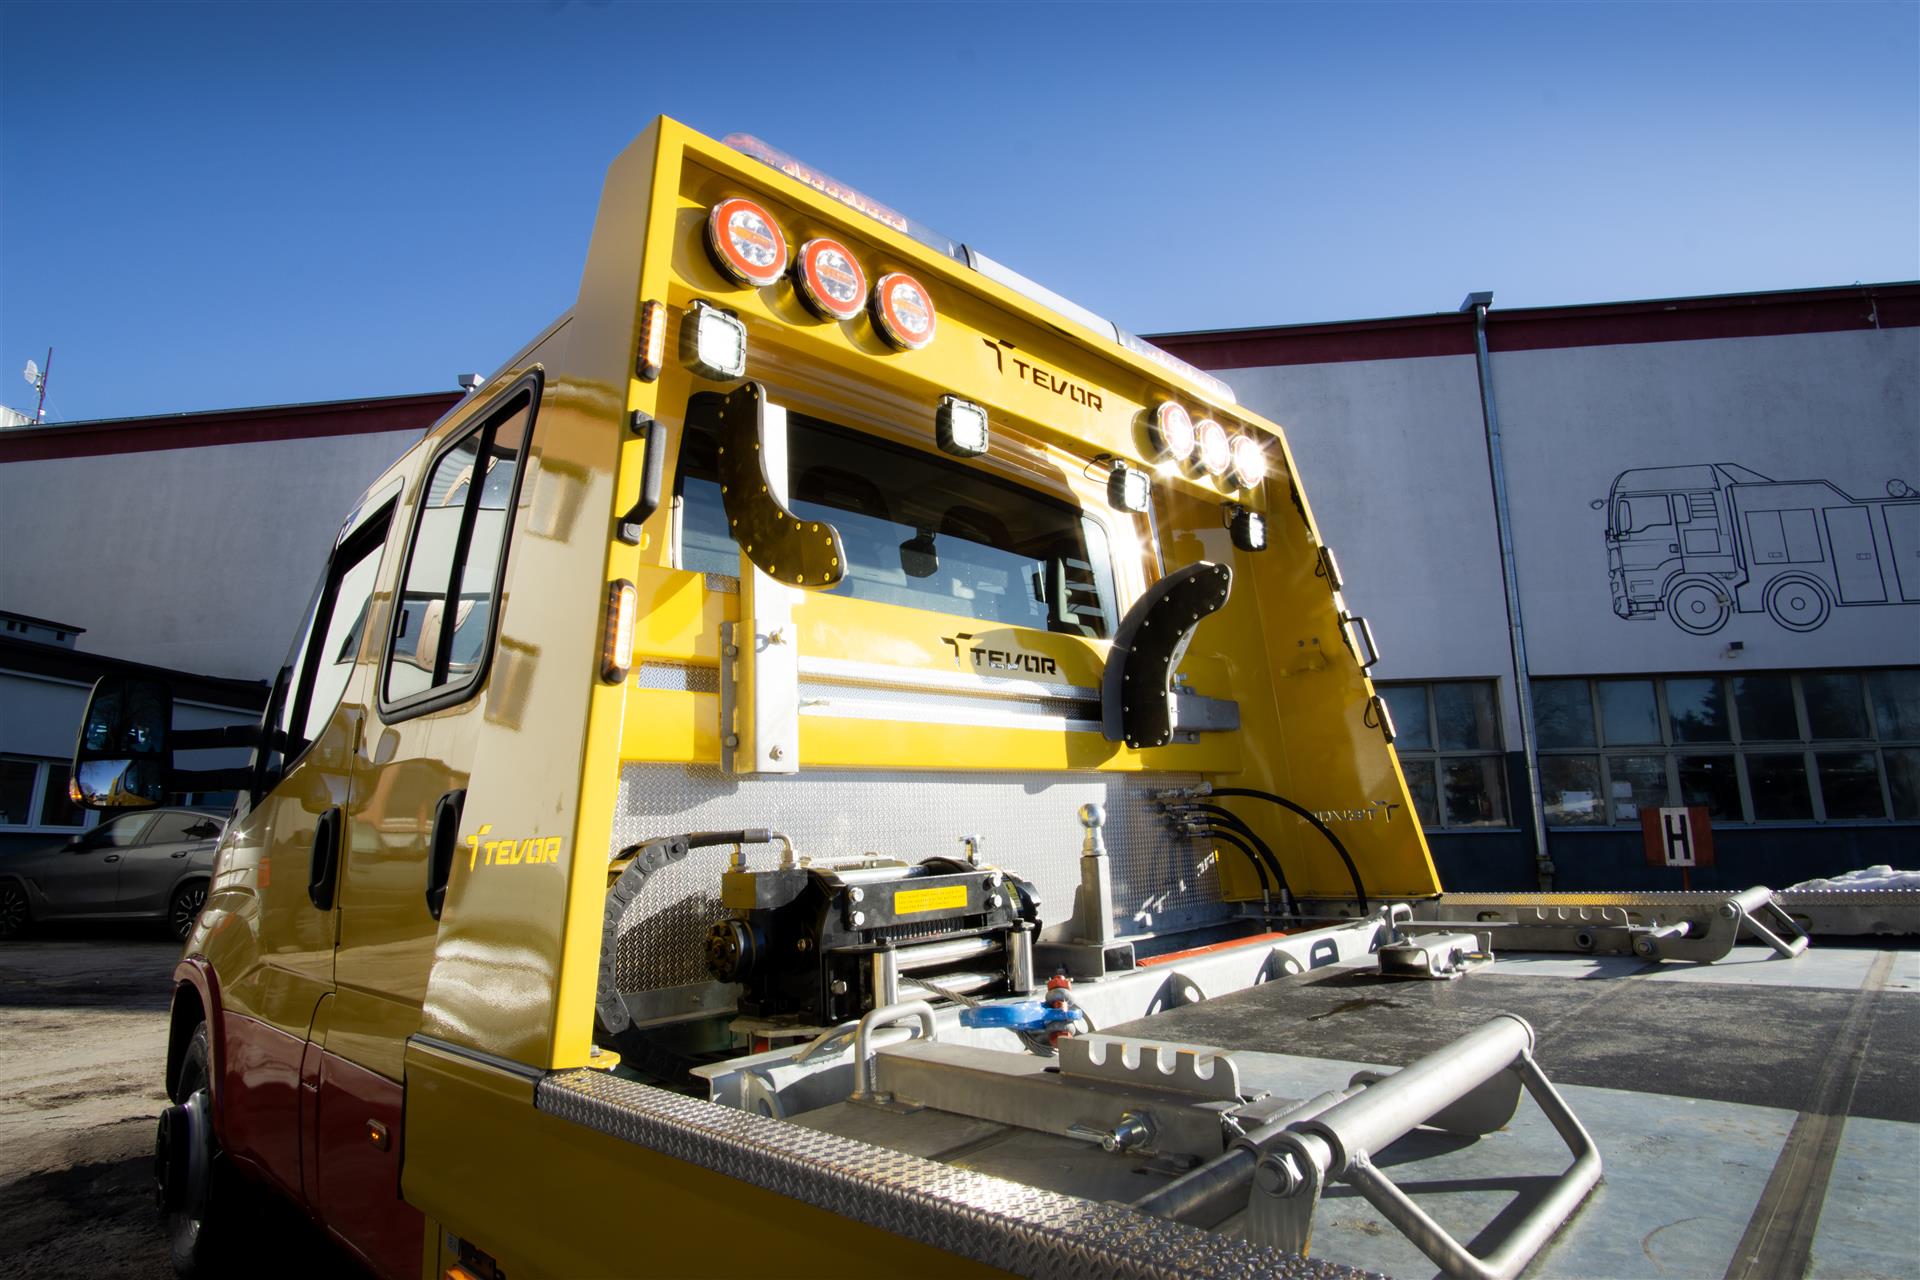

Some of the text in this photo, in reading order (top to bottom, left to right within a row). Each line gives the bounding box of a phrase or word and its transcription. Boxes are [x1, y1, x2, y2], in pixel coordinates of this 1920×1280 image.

[1013, 358, 1103, 413] TEVOR
[970, 647, 1056, 675] TEVOR
[484, 836, 562, 865] TEVOR
[1664, 814, 1691, 860] H
